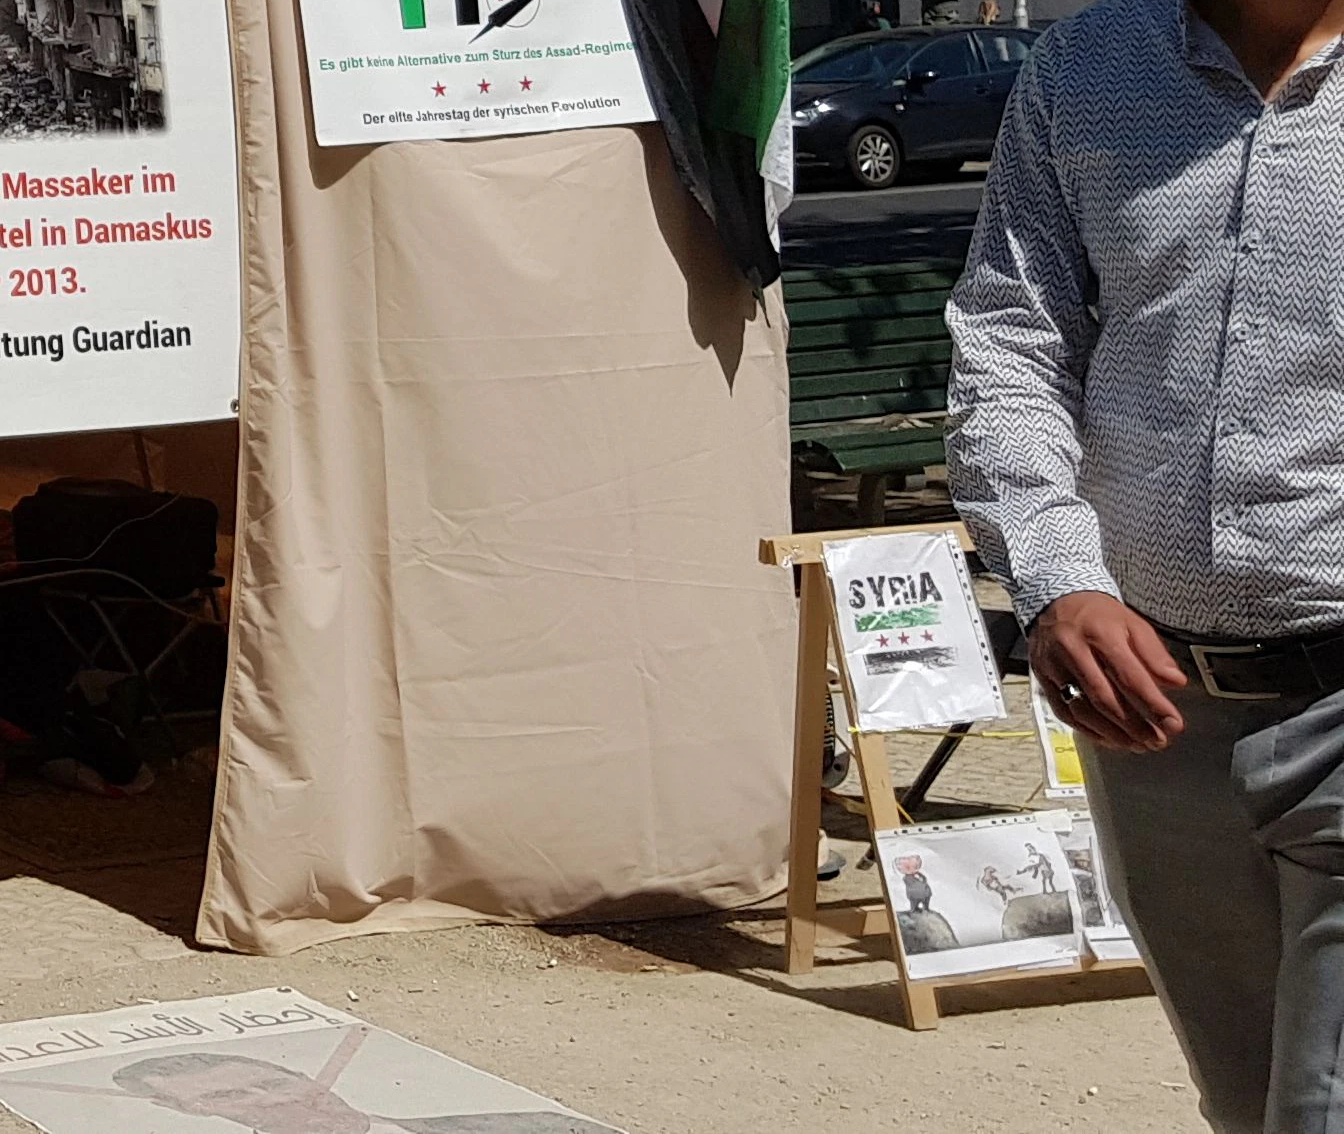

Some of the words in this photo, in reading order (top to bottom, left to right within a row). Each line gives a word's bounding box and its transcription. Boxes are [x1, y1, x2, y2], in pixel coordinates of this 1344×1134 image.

[319, 58, 335, 71] Es
[340, 57, 364, 72] gibt
[367, 56, 394, 67] keine
[397, 53, 461, 67] Alternative
[465, 52, 489, 63] zum
[492, 49, 521, 61] Sturz
[524, 47, 542, 59] des
[363, 113, 385, 125] Der
[389, 111, 413, 123] elfte
[416, 109, 470, 123] Jahrestag
[472, 107, 490, 118] der
[494, 103, 549, 119] syrischen
[551, 97, 621, 112] Revolution
[2, 168, 134, 200] Massaker
[141, 165, 176, 193] im
[40, 218, 67, 246] in
[75, 212, 212, 245] Damaskus
[9, 267, 86, 297] 2013.
[73, 320, 192, 353] Guardian
[848, 572, 943, 610] SYRIA
[219, 1003, 345, 1035] إحضار
